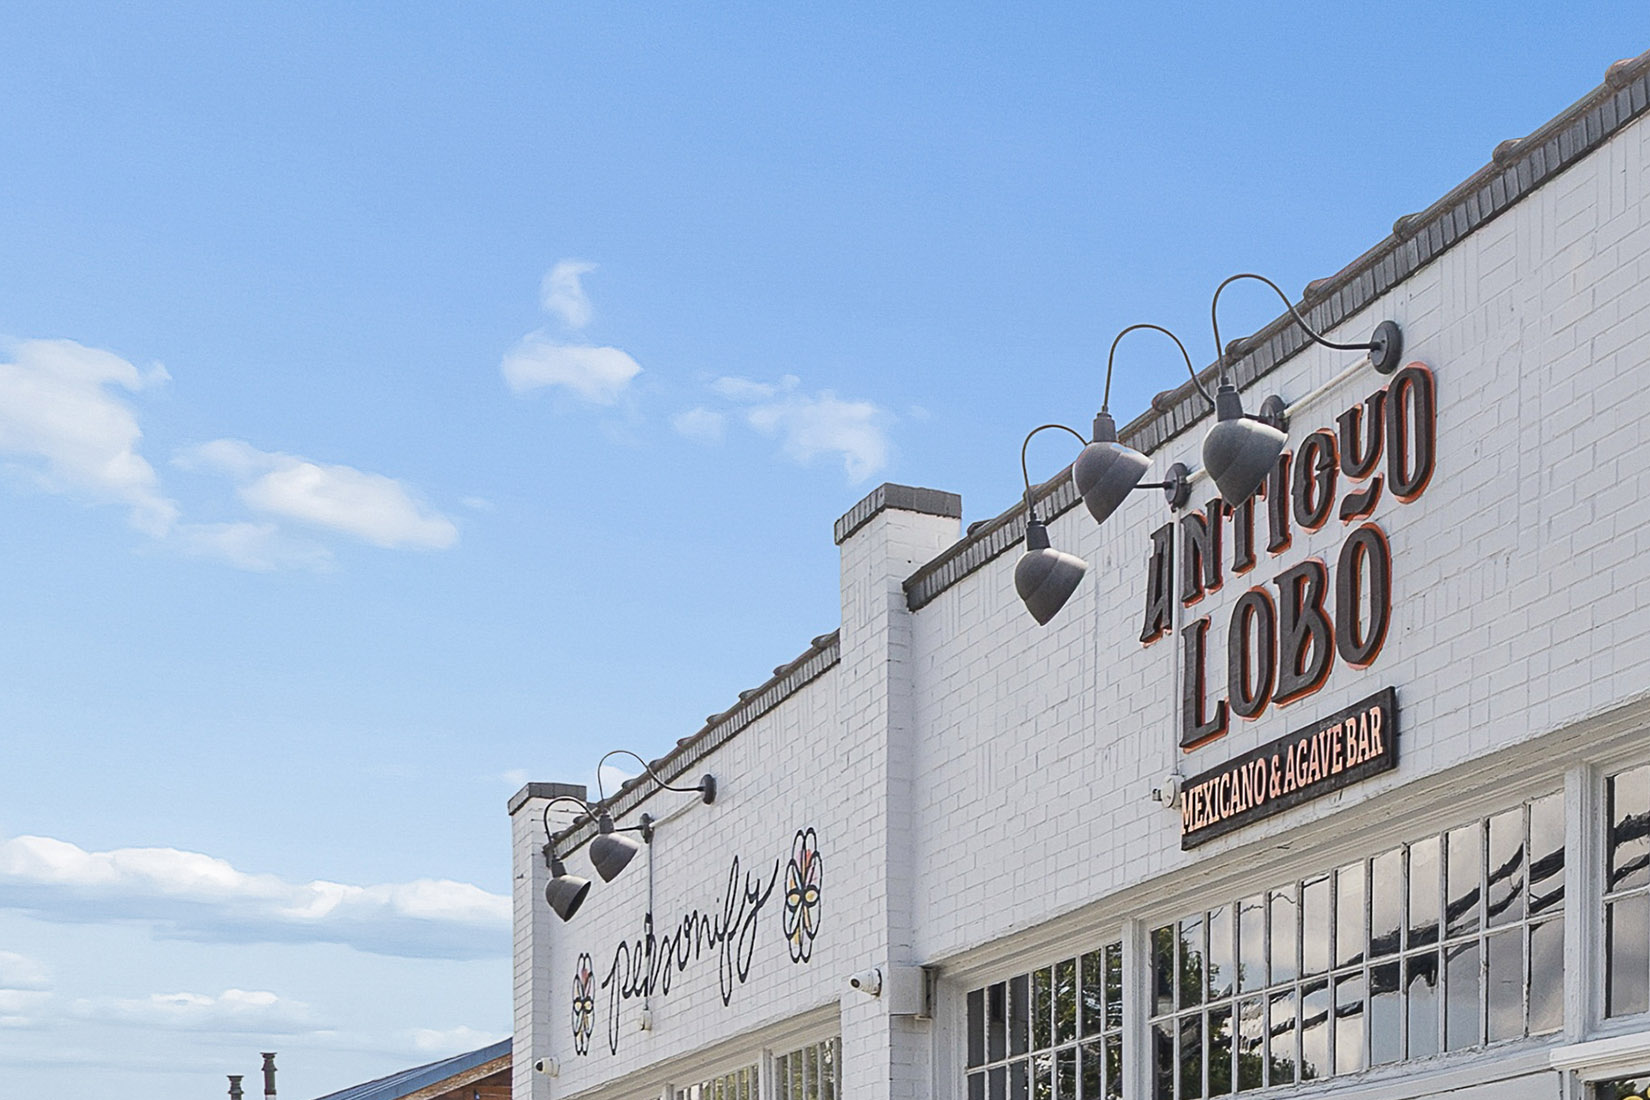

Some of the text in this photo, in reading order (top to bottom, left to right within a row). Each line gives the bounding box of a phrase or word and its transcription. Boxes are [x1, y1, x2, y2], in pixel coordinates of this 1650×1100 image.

[1180, 522, 1393, 754] LOBO
[1180, 704, 1384, 836] MEXICANO & AGAVE BAR
[602, 855, 780, 1056] personify
